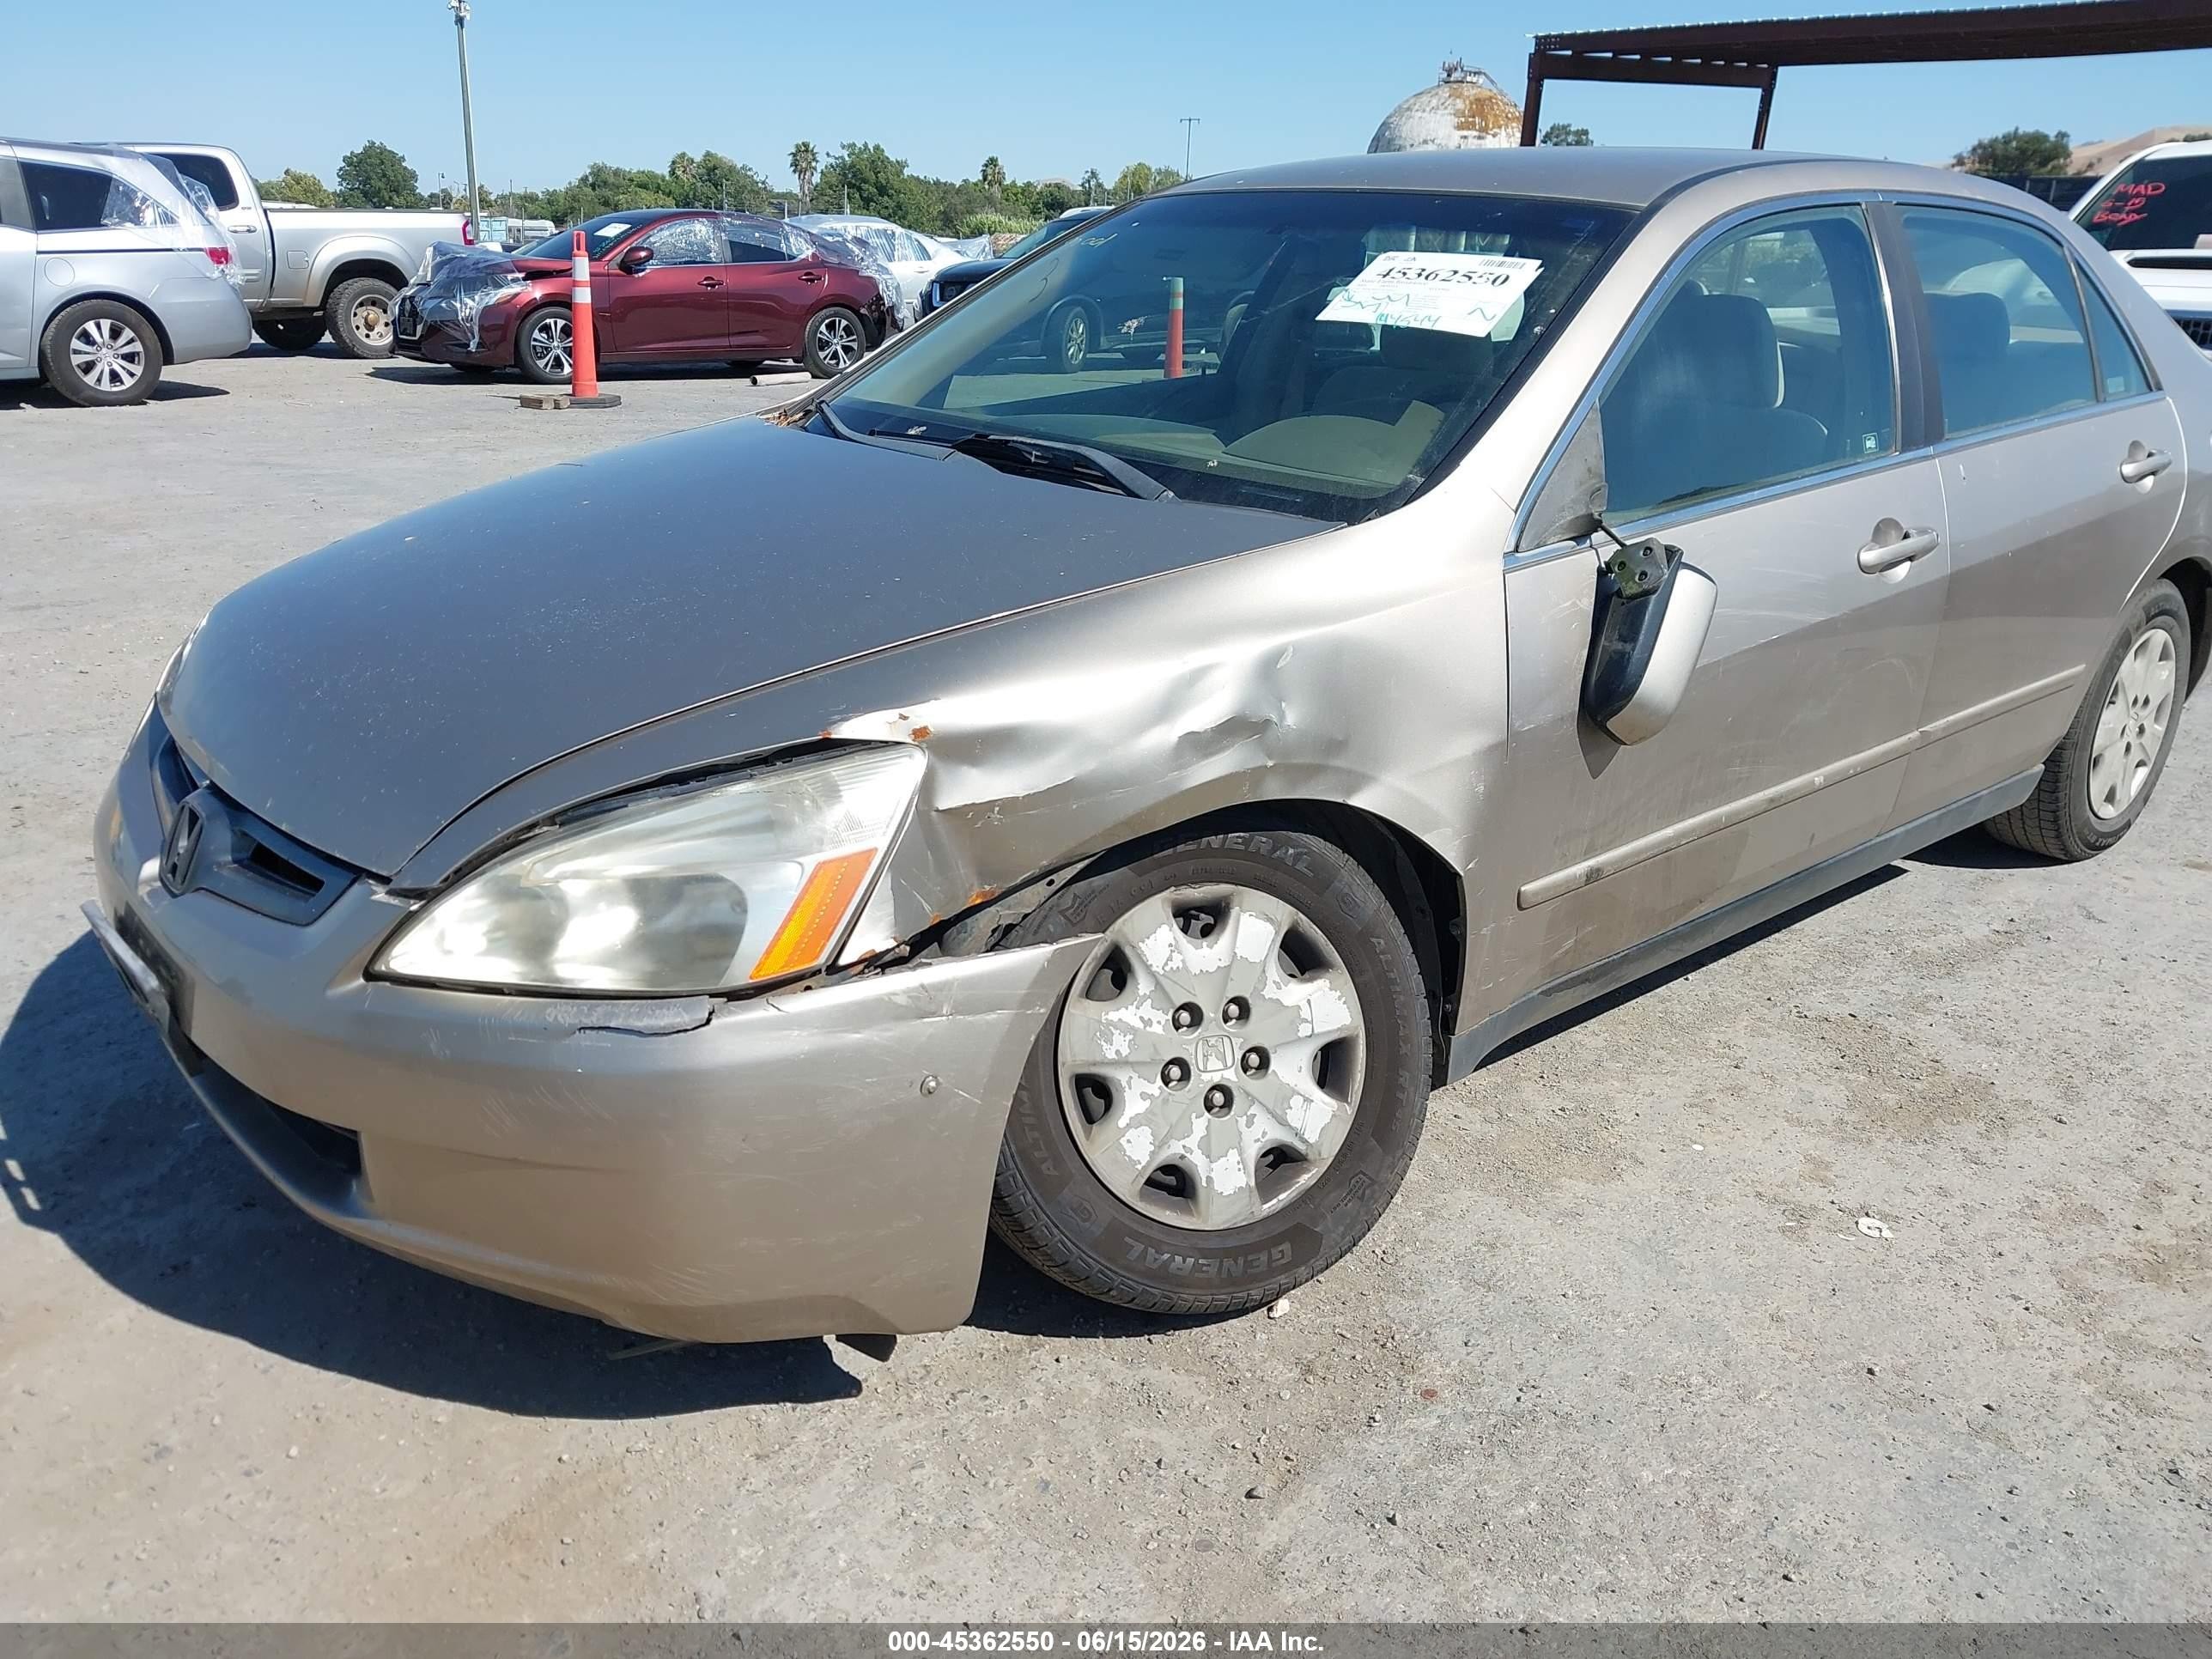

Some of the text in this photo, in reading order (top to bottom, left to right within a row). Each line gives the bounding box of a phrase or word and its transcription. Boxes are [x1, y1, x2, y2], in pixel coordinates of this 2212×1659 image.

[2113, 182, 2166, 197] MAD
[1376, 266, 1510, 288] 45362550
[1156, 832, 1315, 878] ENERAL
[1123, 1237, 1292, 1279] GENERAL
